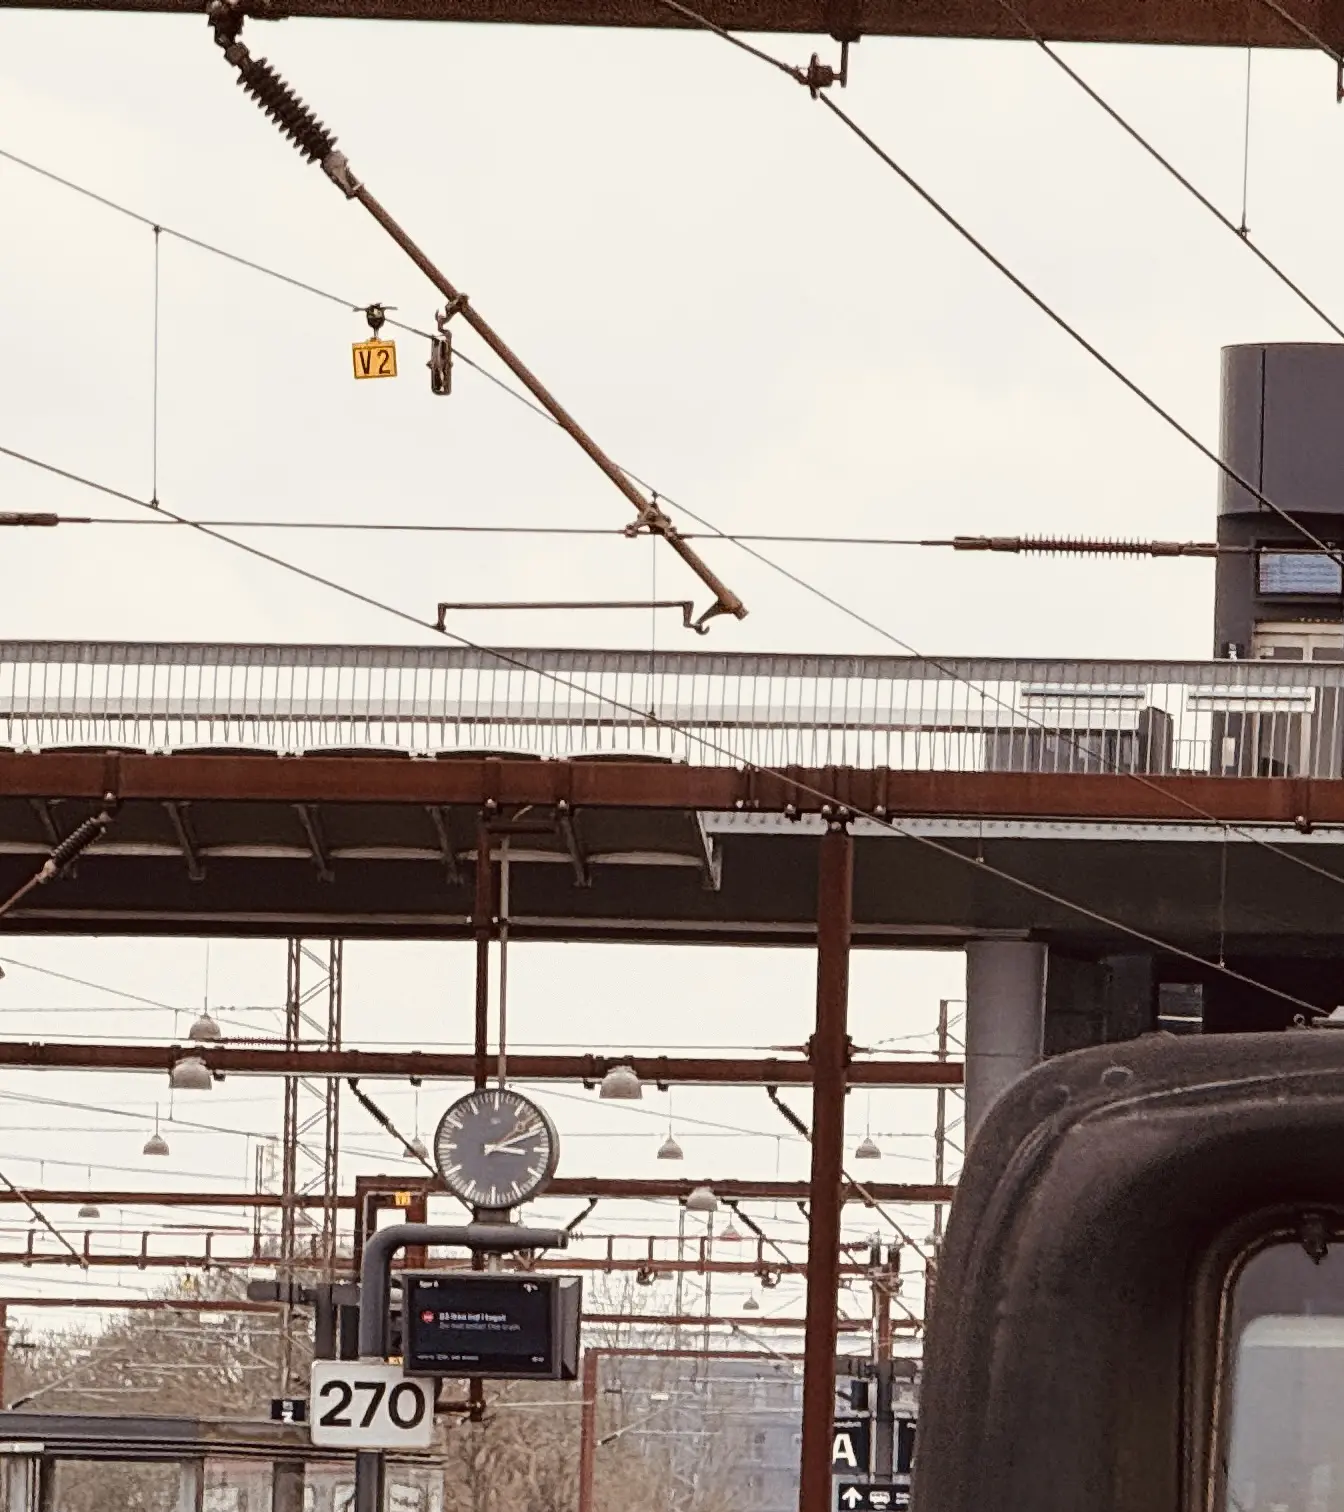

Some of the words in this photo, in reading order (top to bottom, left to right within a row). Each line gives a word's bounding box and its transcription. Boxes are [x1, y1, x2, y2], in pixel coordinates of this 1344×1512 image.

[359, 350, 391, 375] V2
[319, 1379, 426, 1430] 270
[831, 1433, 858, 1467] A
